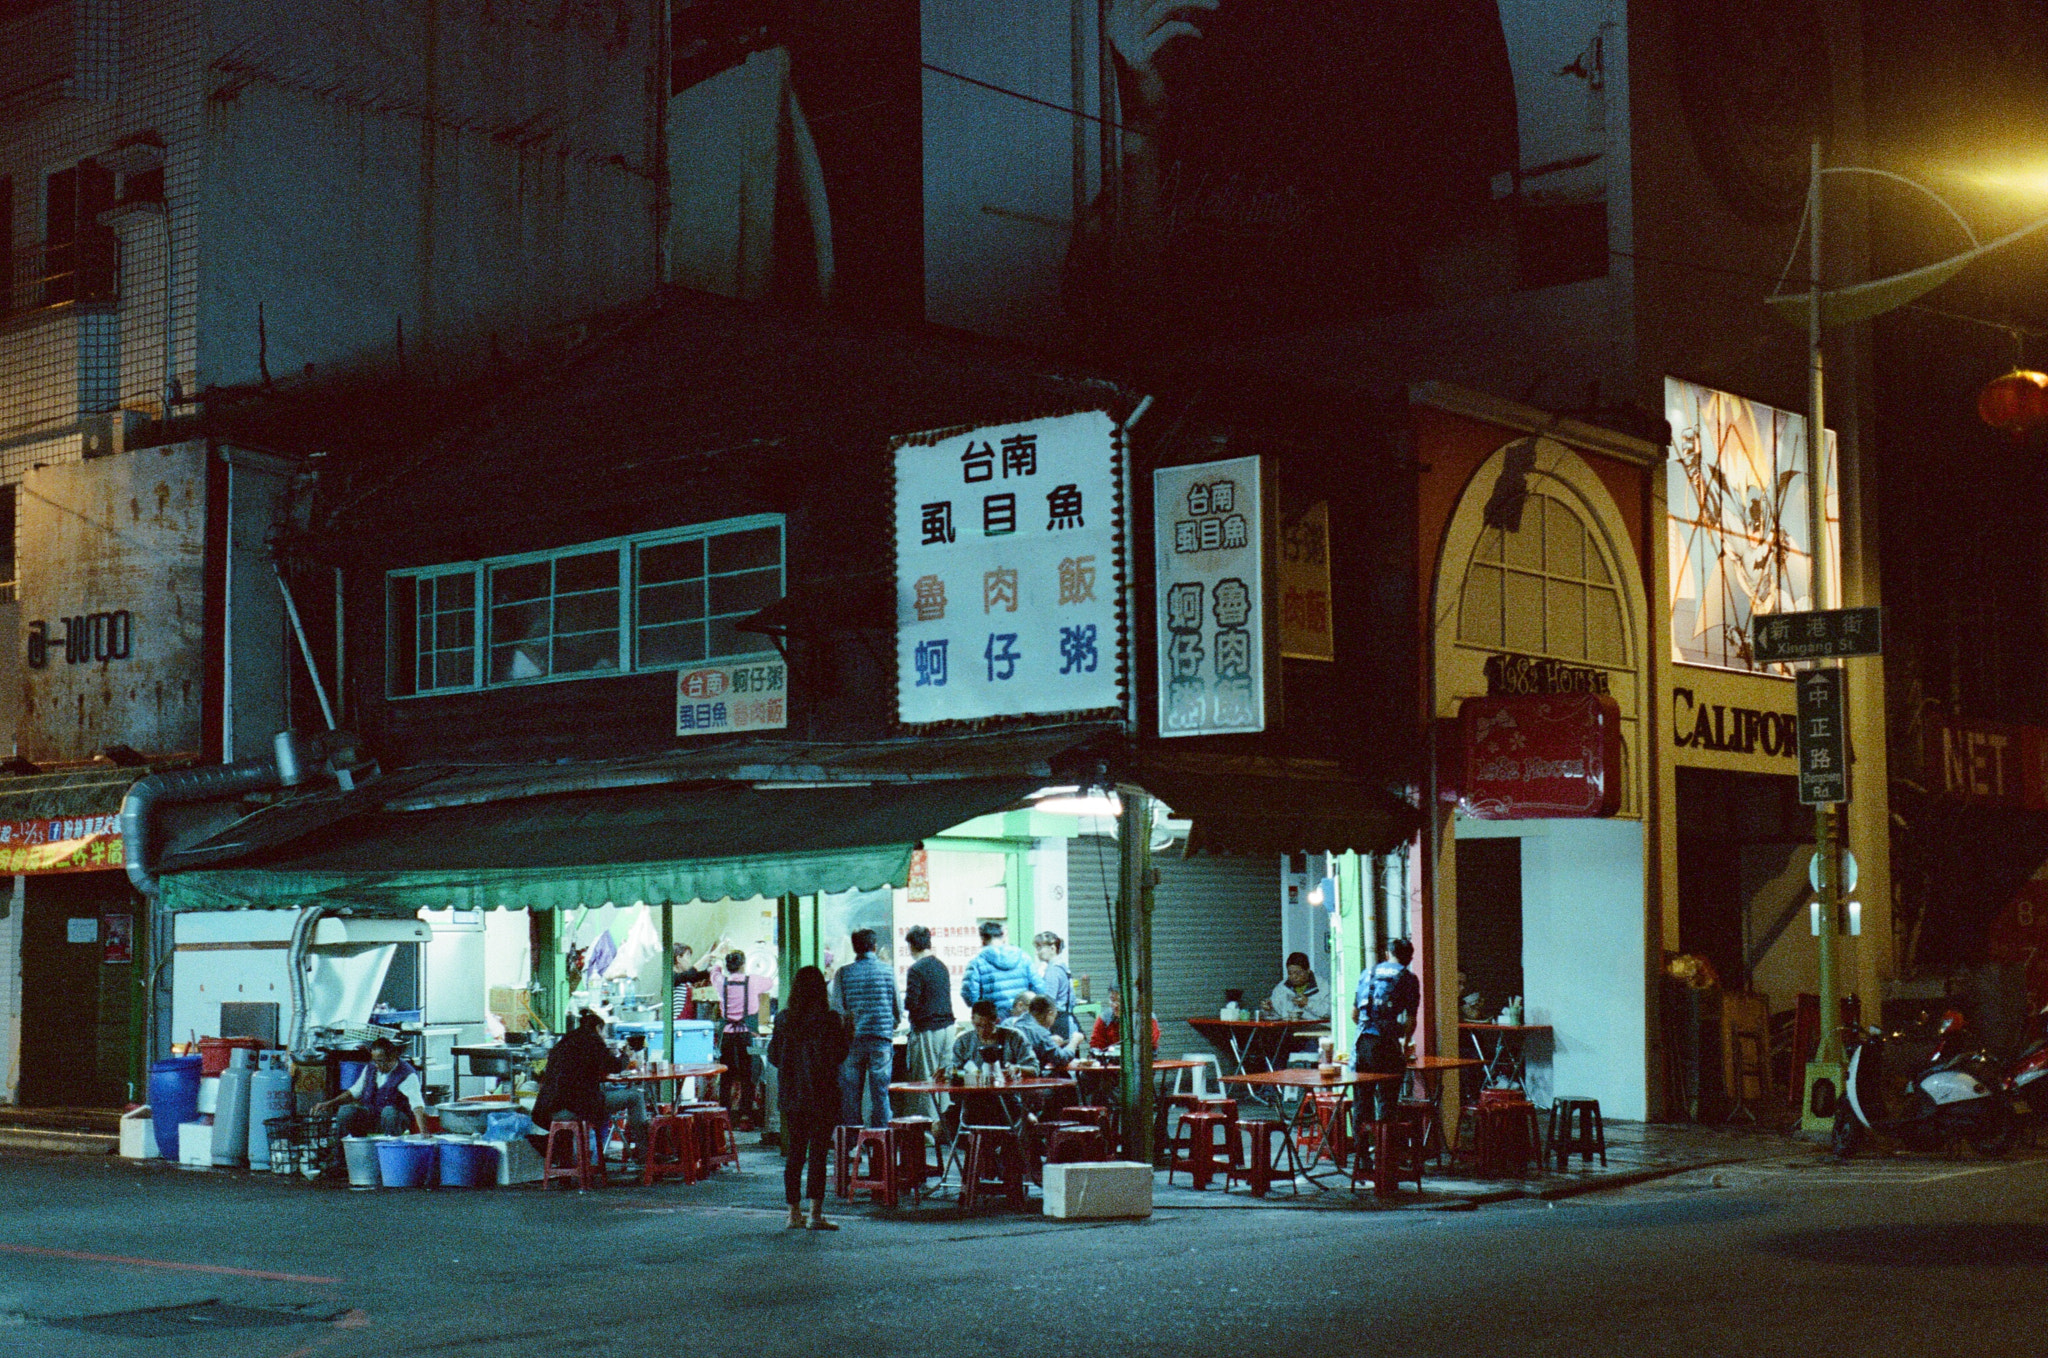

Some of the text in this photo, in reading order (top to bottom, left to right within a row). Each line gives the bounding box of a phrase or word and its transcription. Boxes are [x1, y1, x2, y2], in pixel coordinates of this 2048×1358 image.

[960, 434, 1038, 484] 台南
[1186, 479, 1236, 517] 台南
[1174, 515, 1249, 554] 虱目魚
[912, 555, 1098, 622] 魯肉飯
[1770, 613, 1864, 641] 新港街
[914, 623, 1099, 688] 蚵仔粥
[1776, 640, 1833, 656] Xingang
[687, 672, 723, 698] 台南
[1808, 685, 1832, 769] 中正路
